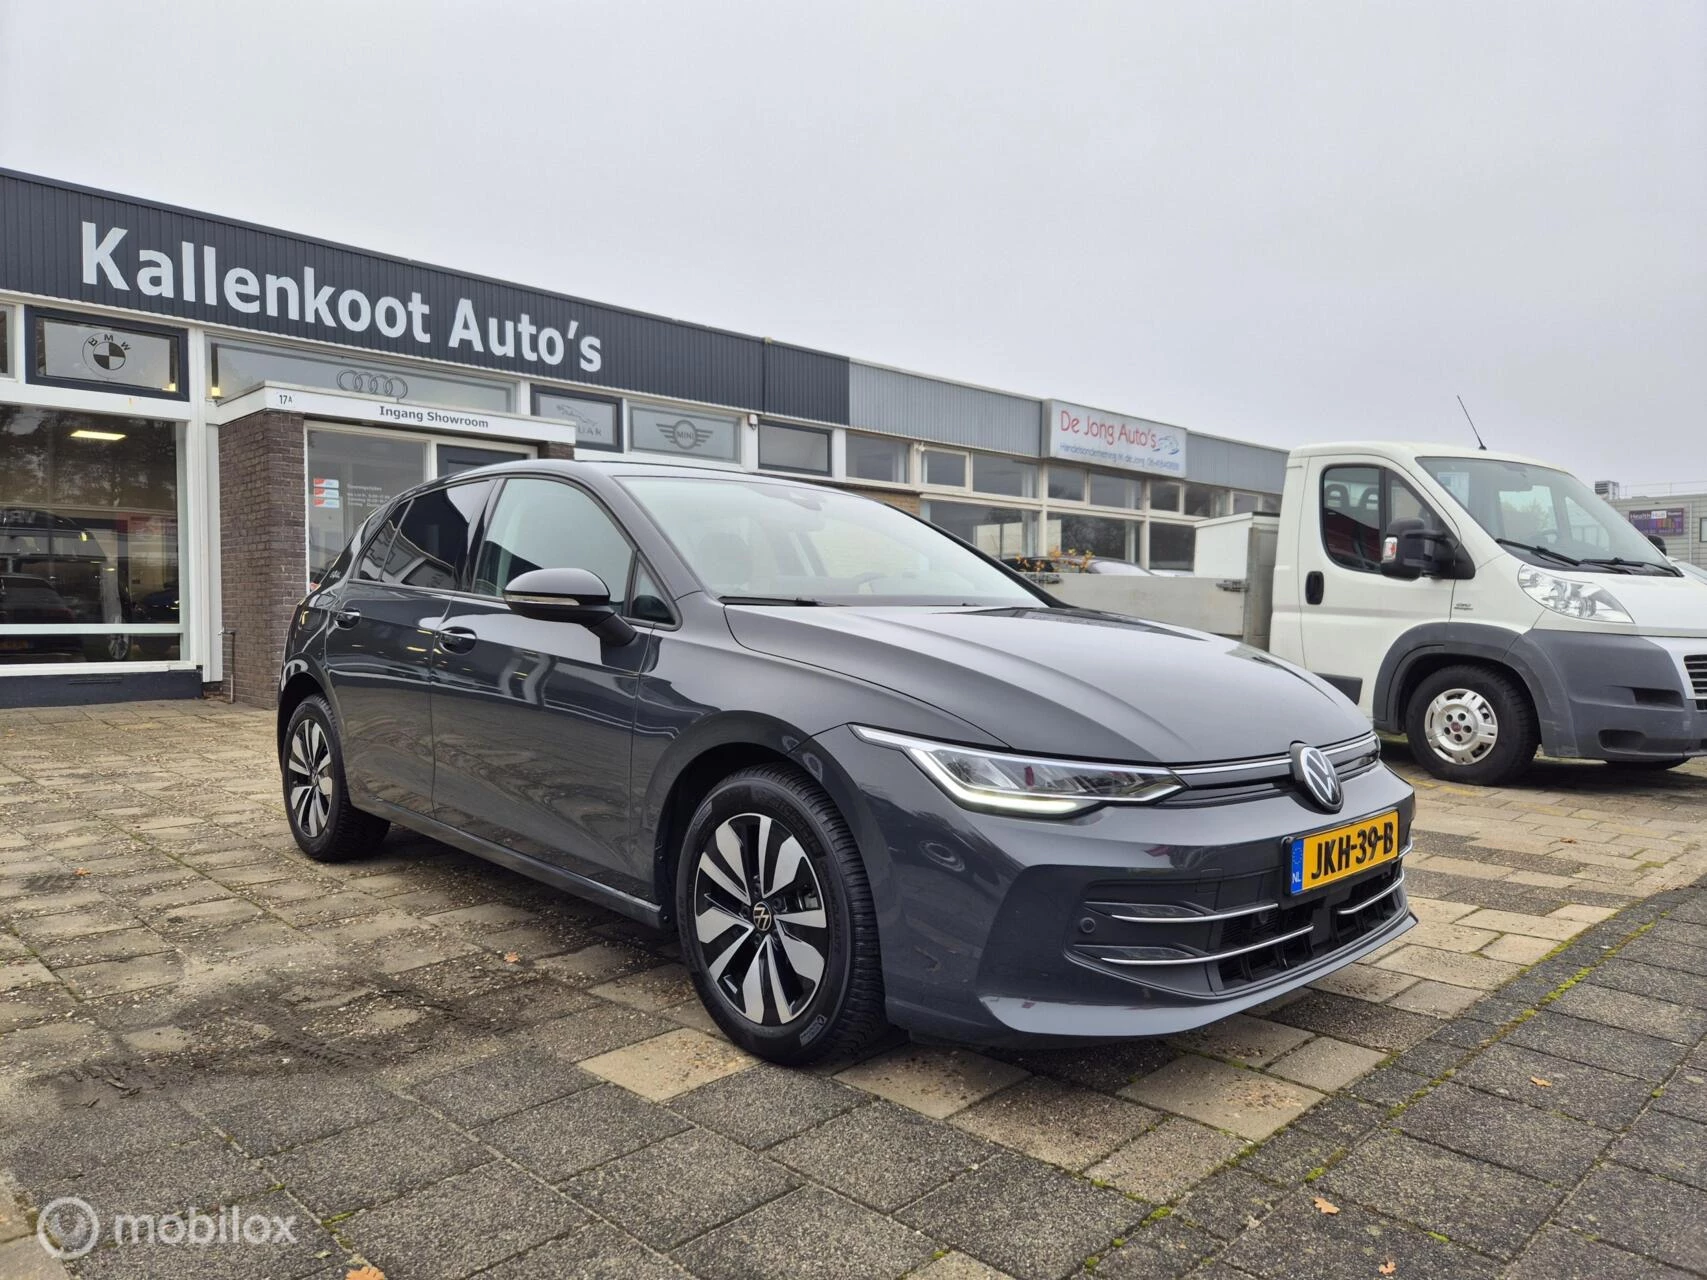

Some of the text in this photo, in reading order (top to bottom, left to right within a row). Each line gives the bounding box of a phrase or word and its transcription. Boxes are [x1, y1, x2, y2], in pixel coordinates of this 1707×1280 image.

[82, 221, 602, 372] Kallenkoot Auto's
[88, 334, 131, 350] BMW
[279, 394, 293, 404] 17A
[379, 405, 489, 429] Ingang Showroom
[577, 425, 602, 437] UAR
[676, 430, 695, 441] MINI
[1060, 410, 1157, 449] De Jong Auto's
[1311, 822, 1394, 880] JKH-39-B
[1292, 872, 1302, 885] NL
